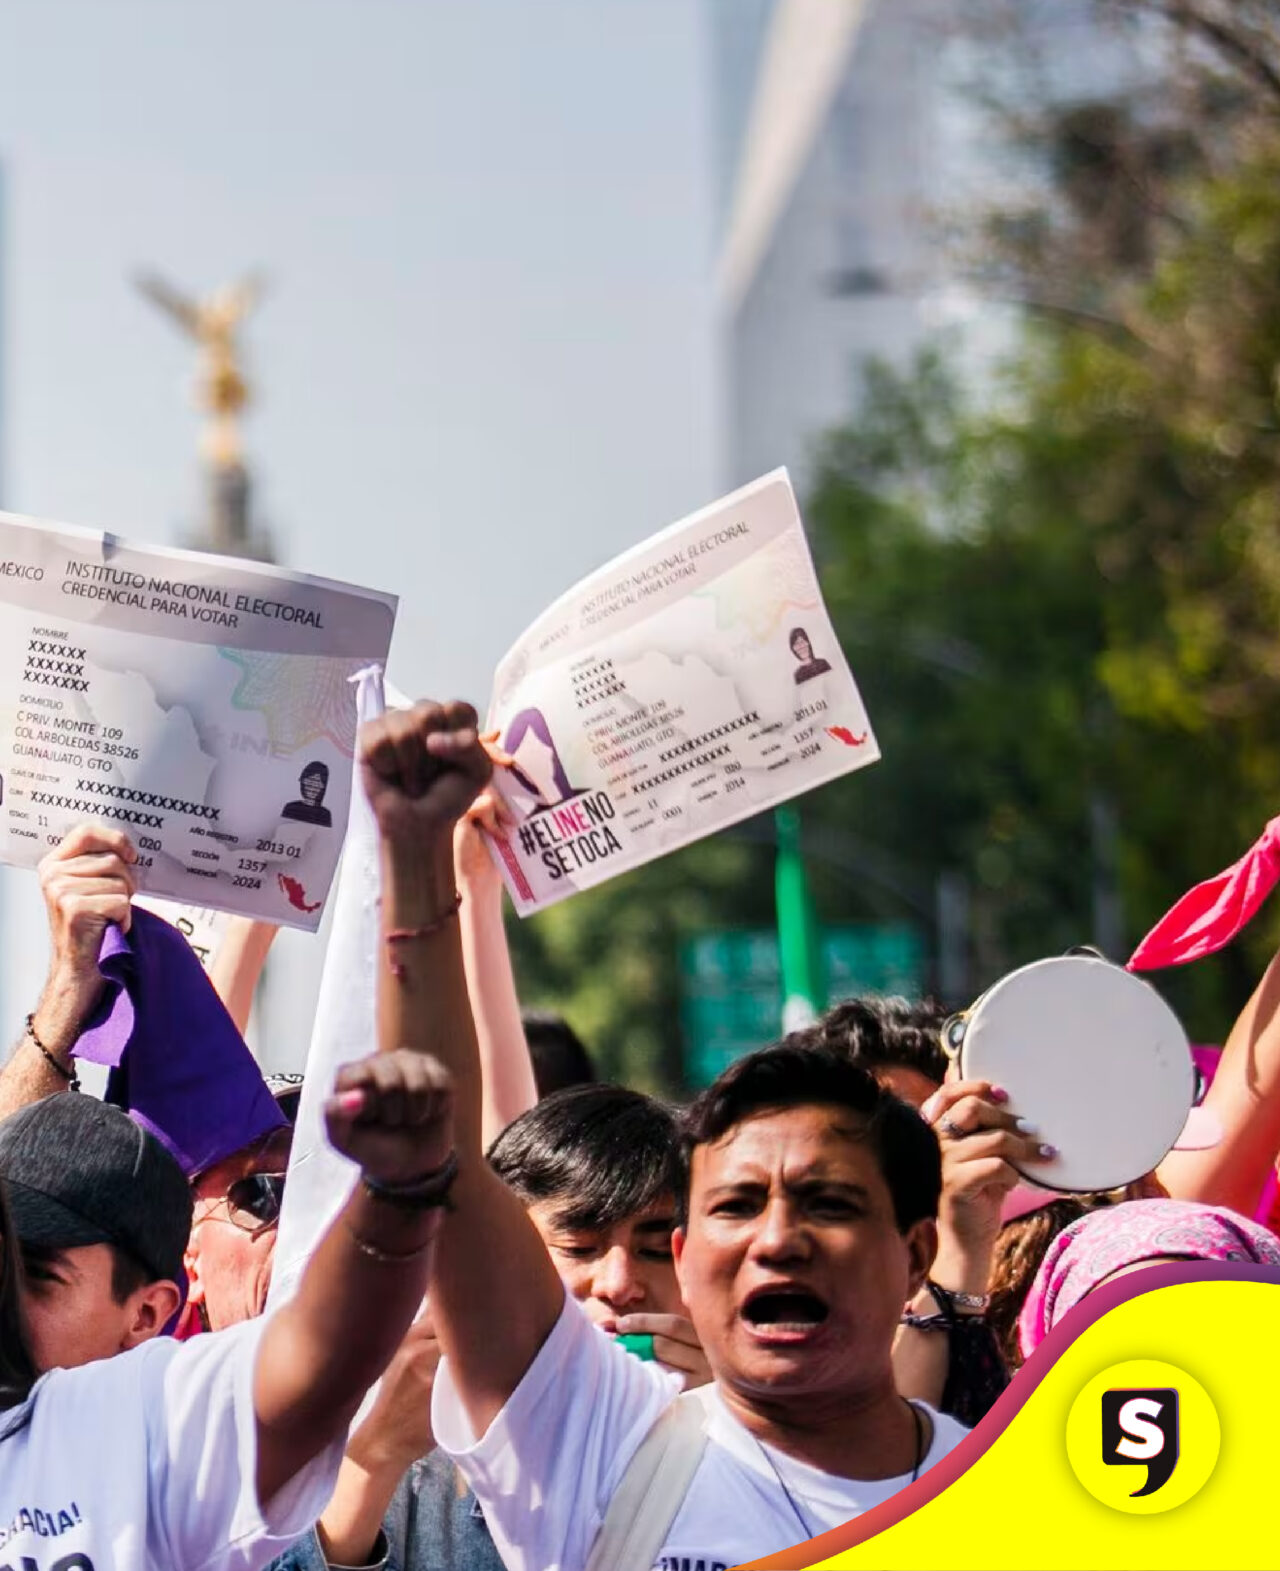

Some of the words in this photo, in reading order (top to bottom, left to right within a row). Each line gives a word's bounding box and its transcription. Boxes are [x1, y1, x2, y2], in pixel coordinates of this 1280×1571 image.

[61, 581, 147, 609] CREDENCIAL
[150, 597, 187, 618] PARA
[191, 605, 239, 629] VOTAR
[65, 560, 146, 589] INSTITUTO
[148, 577, 231, 608] NACIONAL
[234, 595, 324, 629] ELECTORAL
[28, 640, 86, 660] XXXXXX
[26, 655, 84, 676] XXXXXX
[23, 670, 90, 692] XXXXXXX
[16, 711, 25, 722] C
[53, 717, 96, 735] MONTE
[102, 726, 124, 741] 109
[15, 726, 33, 740] COL
[36, 730, 100, 752] ARBOLEDAS
[103, 743, 139, 760] 38526
[87, 758, 113, 773] GTO
[38, 814, 48, 828] 11
[518, 791, 616, 856] #ELINENO
[139, 836, 162, 851] 020
[256, 839, 284, 855] 2013
[286, 845, 301, 858] 01
[541, 825, 623, 880] SETOCA
[238, 858, 268, 873] 1357
[232, 875, 262, 890] 2024
